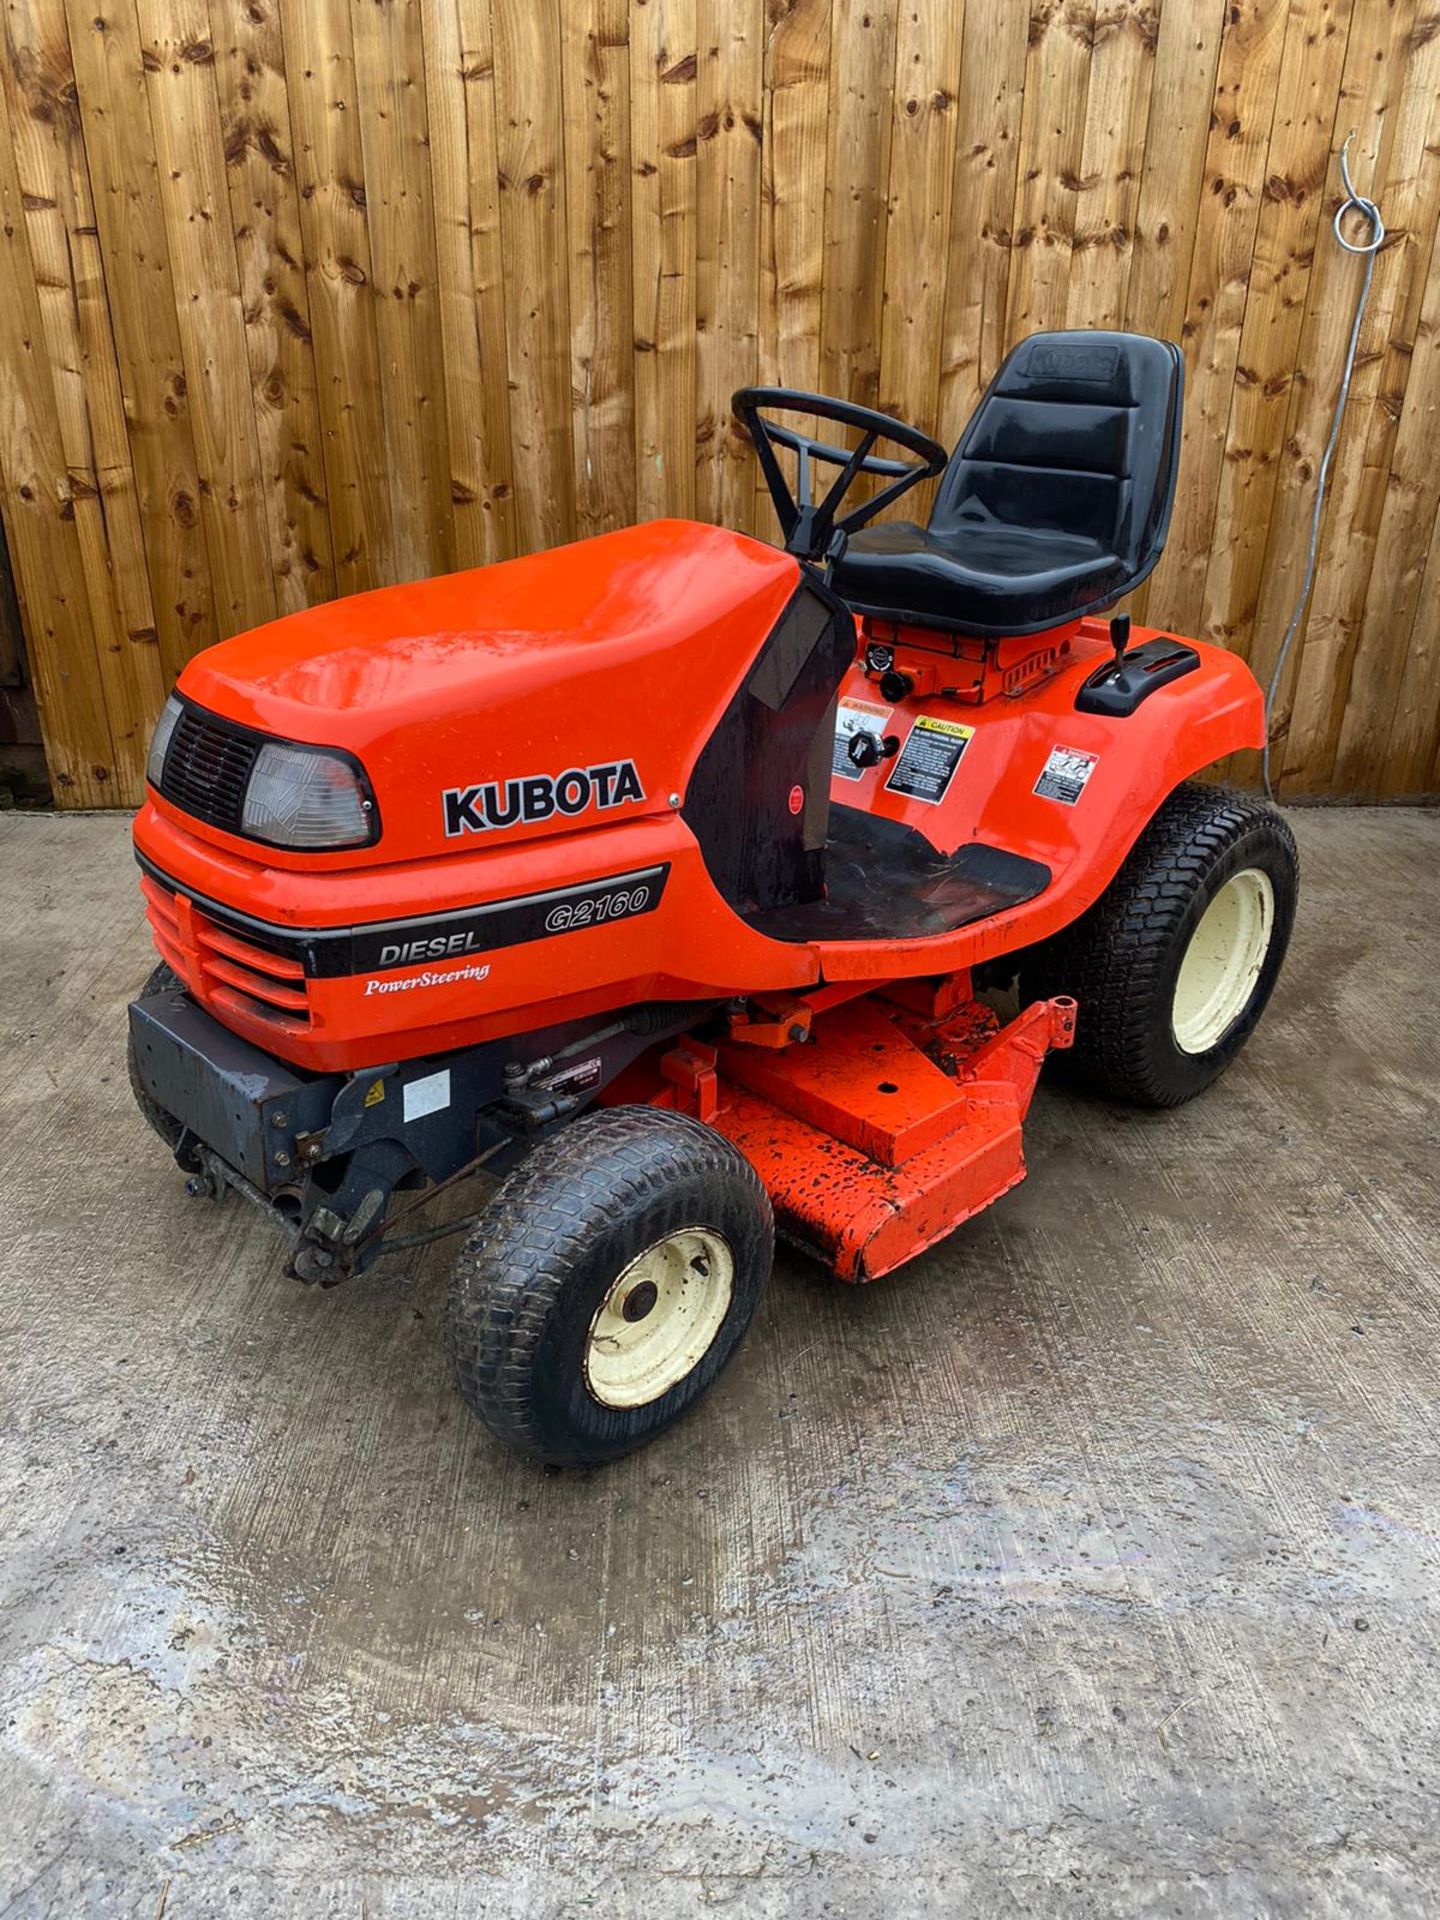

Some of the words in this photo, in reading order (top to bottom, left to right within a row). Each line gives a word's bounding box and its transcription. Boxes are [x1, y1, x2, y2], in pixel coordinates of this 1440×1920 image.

[930, 721, 965, 735] CAUTION
[443, 758, 646, 837] KUBOTA
[545, 886, 650, 931] G2160
[379, 931, 481, 965] DIESEL
[364, 963, 490, 996] PowerSteering
